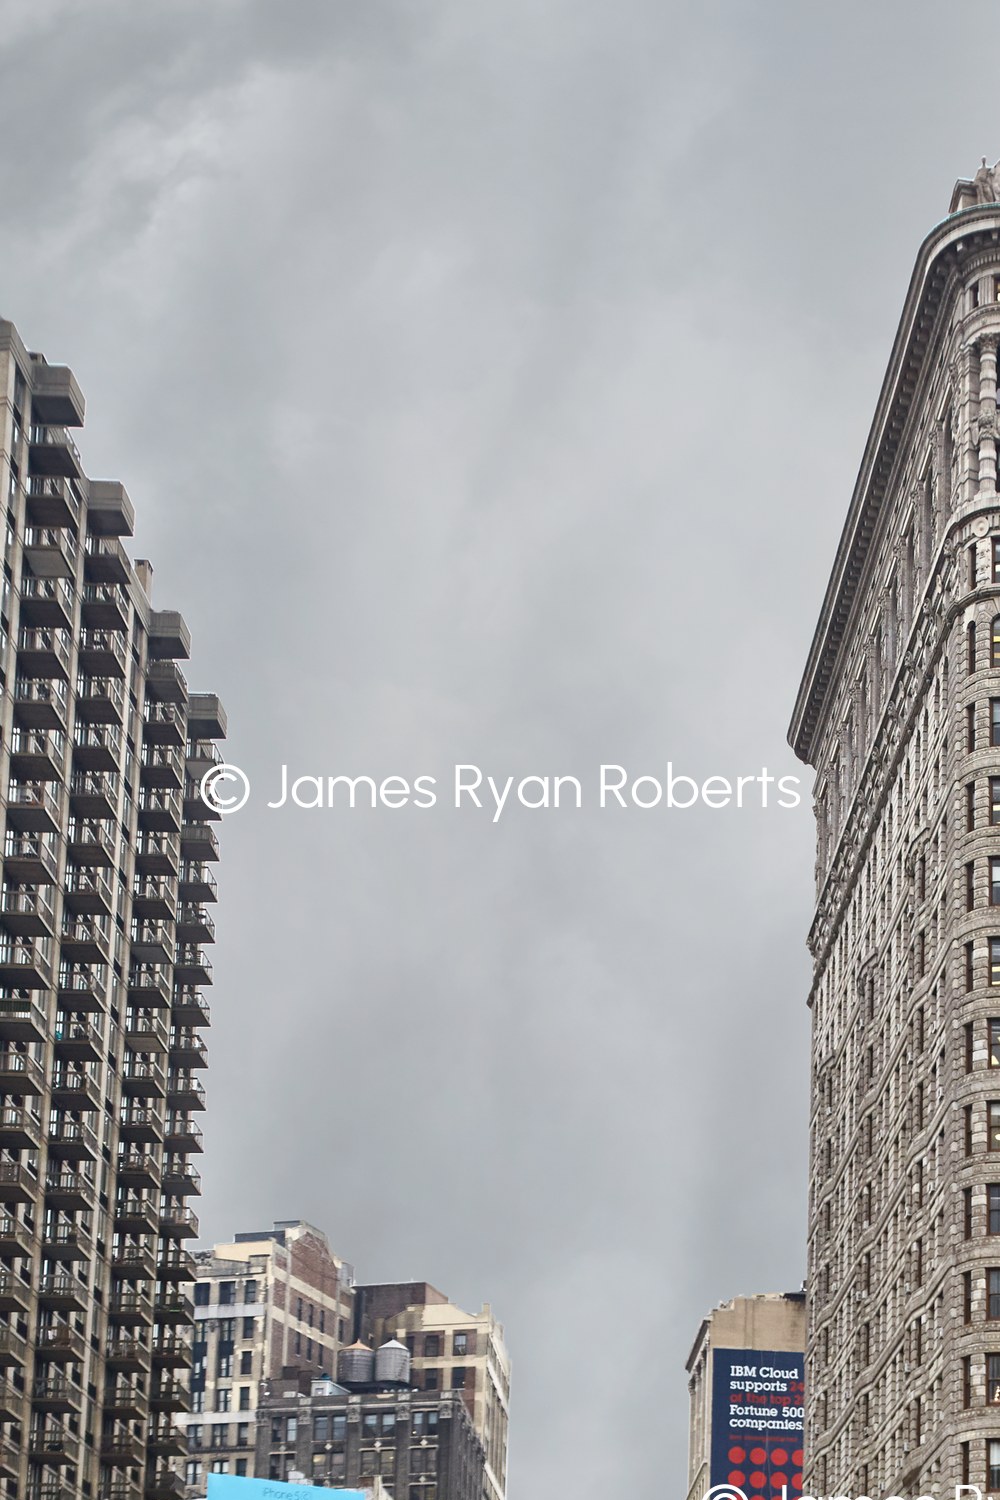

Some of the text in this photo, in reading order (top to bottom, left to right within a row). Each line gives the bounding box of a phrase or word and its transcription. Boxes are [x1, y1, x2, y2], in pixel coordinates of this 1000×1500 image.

[730, 1365, 799, 1379] IBM Cloud
[729, 1380, 788, 1393] supports
[729, 1393, 742, 1403] of
[745, 1393, 767, 1404] the
[769, 1393, 791, 1406] top
[729, 1404, 805, 1418] Fortune 500
[729, 1418, 804, 1431] companies.
